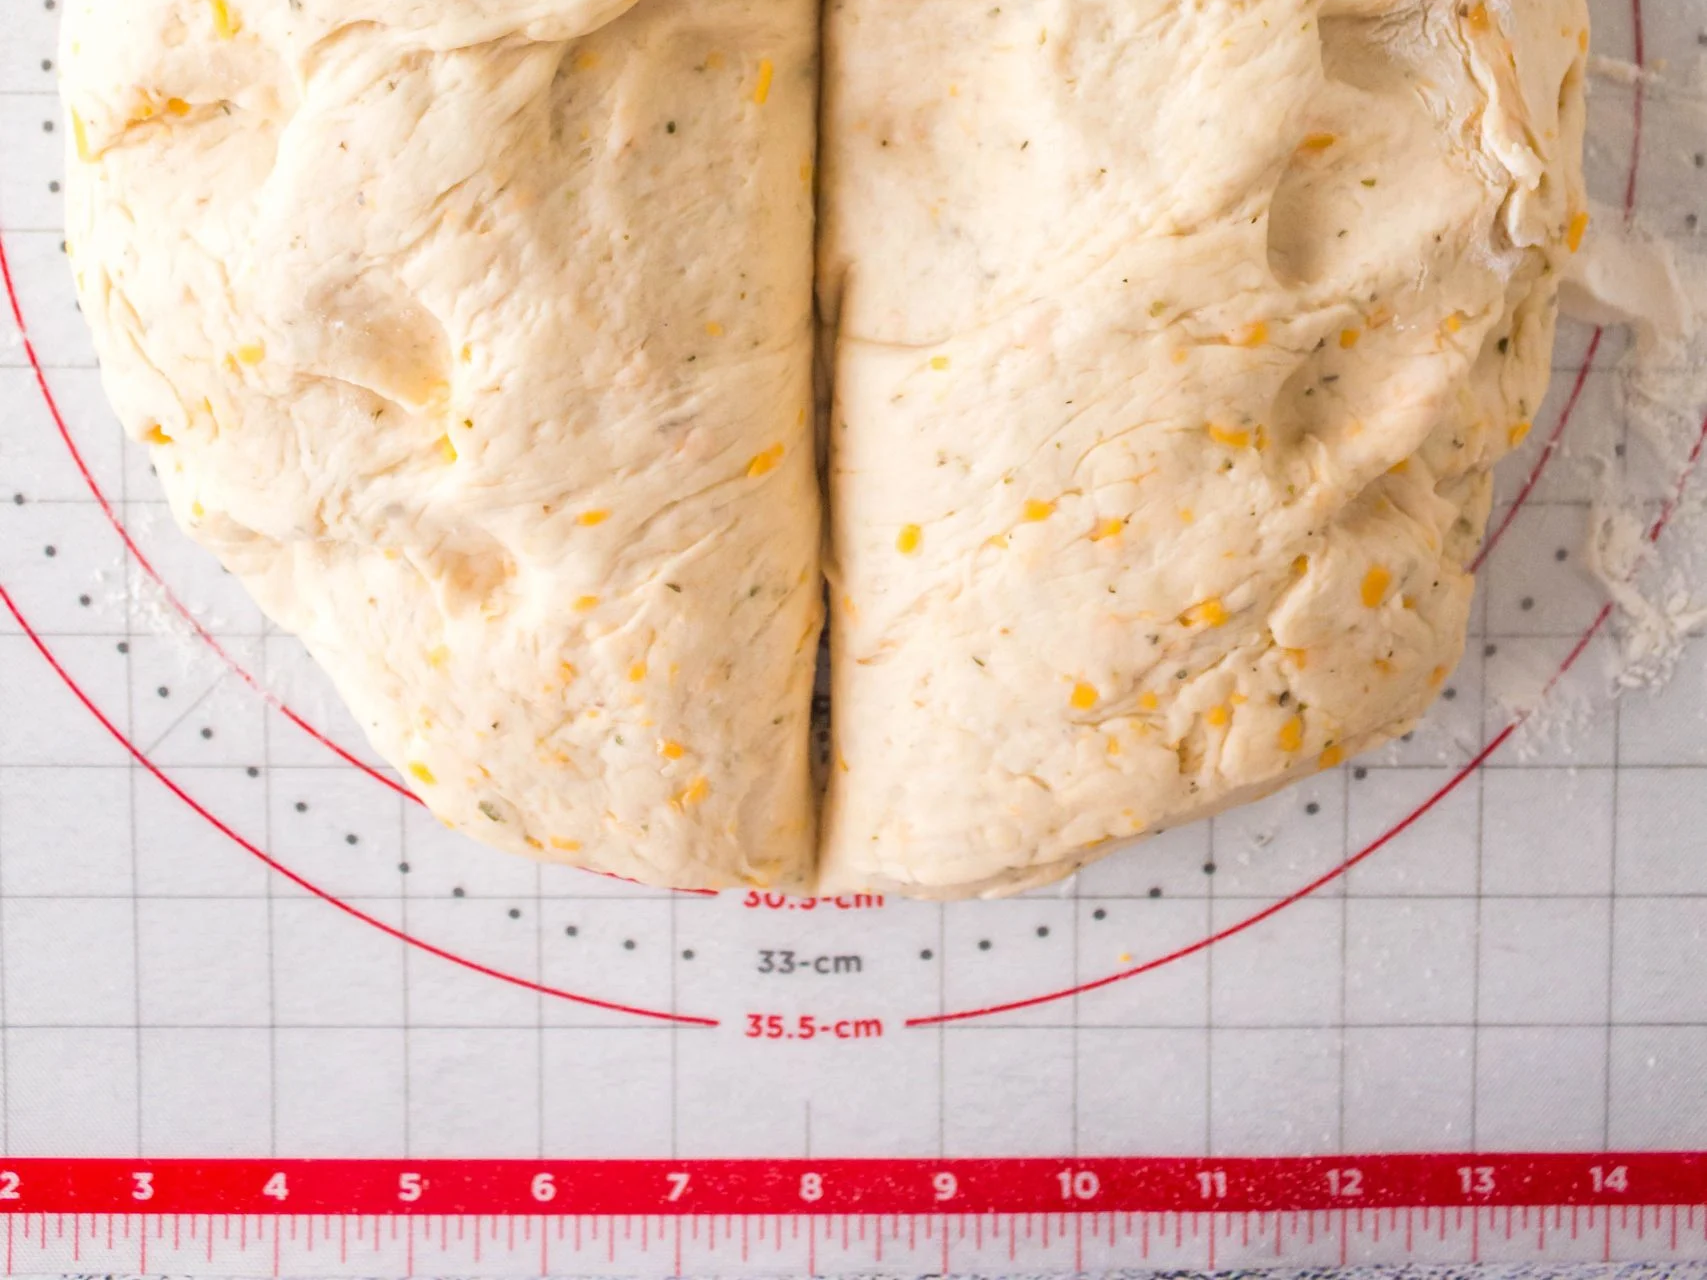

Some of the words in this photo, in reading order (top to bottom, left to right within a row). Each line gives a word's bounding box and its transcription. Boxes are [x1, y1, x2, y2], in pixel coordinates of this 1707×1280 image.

[757, 950, 863, 975] 33-cm
[746, 1014, 883, 1039] 35.5-cm
[0, 1171, 20, 1199] 2
[133, 1172, 153, 1200] 3
[263, 1172, 288, 1200] 4
[400, 1173, 421, 1201] 5
[532, 1173, 555, 1201] 6
[668, 1173, 690, 1201] 7
[801, 1173, 822, 1201] 8
[934, 1172, 956, 1200] 9
[1059, 1171, 1098, 1199] 10
[1197, 1171, 1226, 1198] 11
[1327, 1169, 1364, 1196] 12
[1457, 1167, 1495, 1193] 13
[1589, 1166, 1628, 1192] 14
